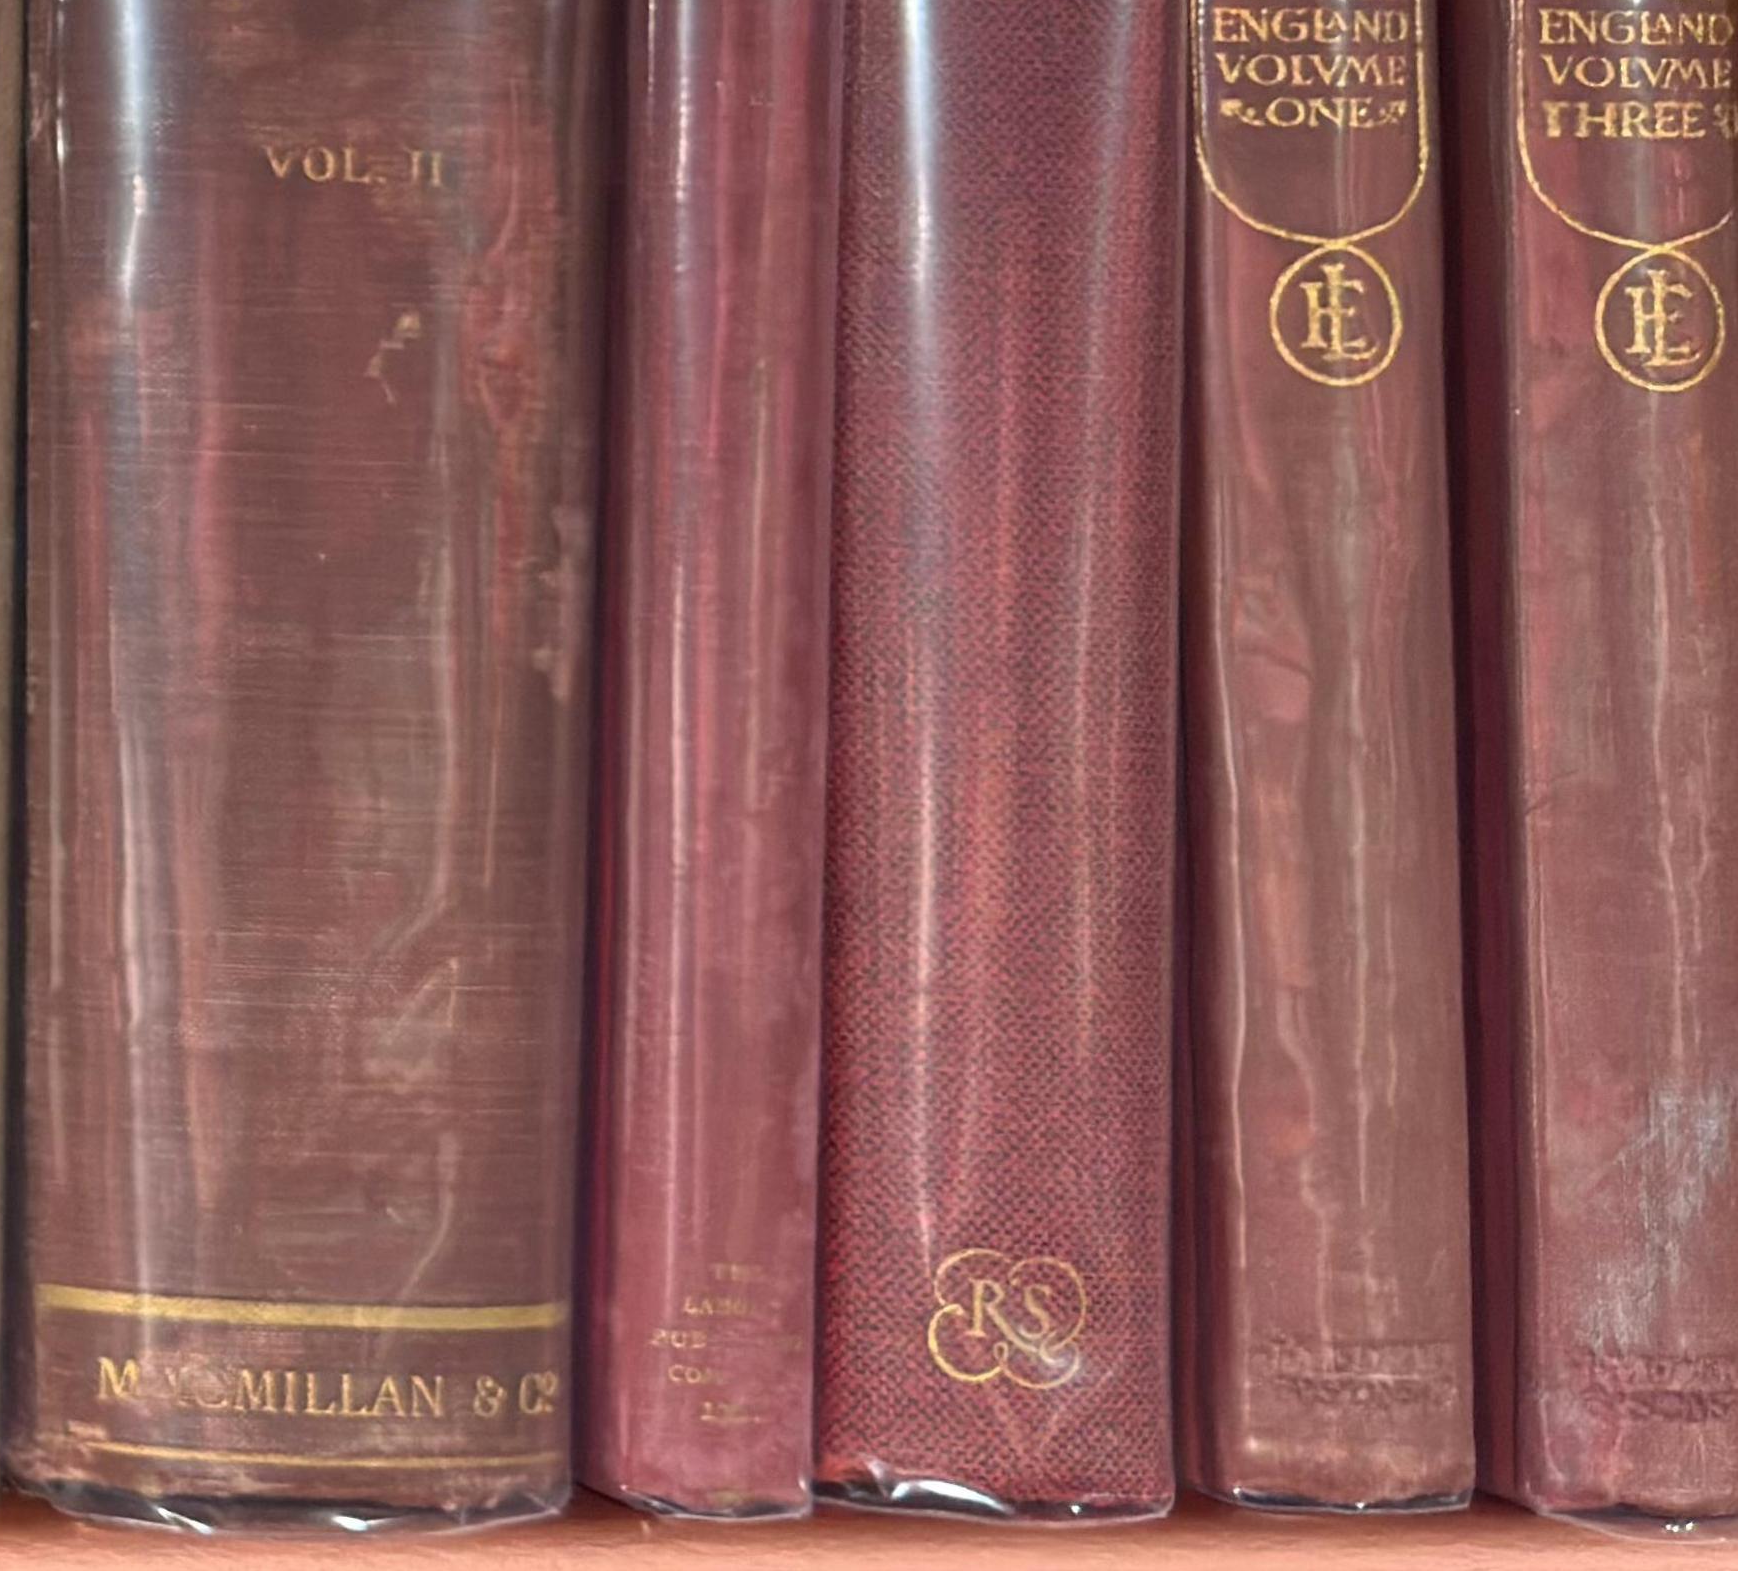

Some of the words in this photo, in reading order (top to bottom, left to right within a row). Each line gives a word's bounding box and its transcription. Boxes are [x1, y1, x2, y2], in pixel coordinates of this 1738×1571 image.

[1212, 7, 1408, 44] ENGLAND
[1539, 8, 1734, 46] ENGLAND
[1264, 97, 1374, 128] ONE
[1541, 100, 1706, 139] THREE
[97, 1356, 444, 1418] MCMILLAN
[472, 1375, 505, 1418] &
